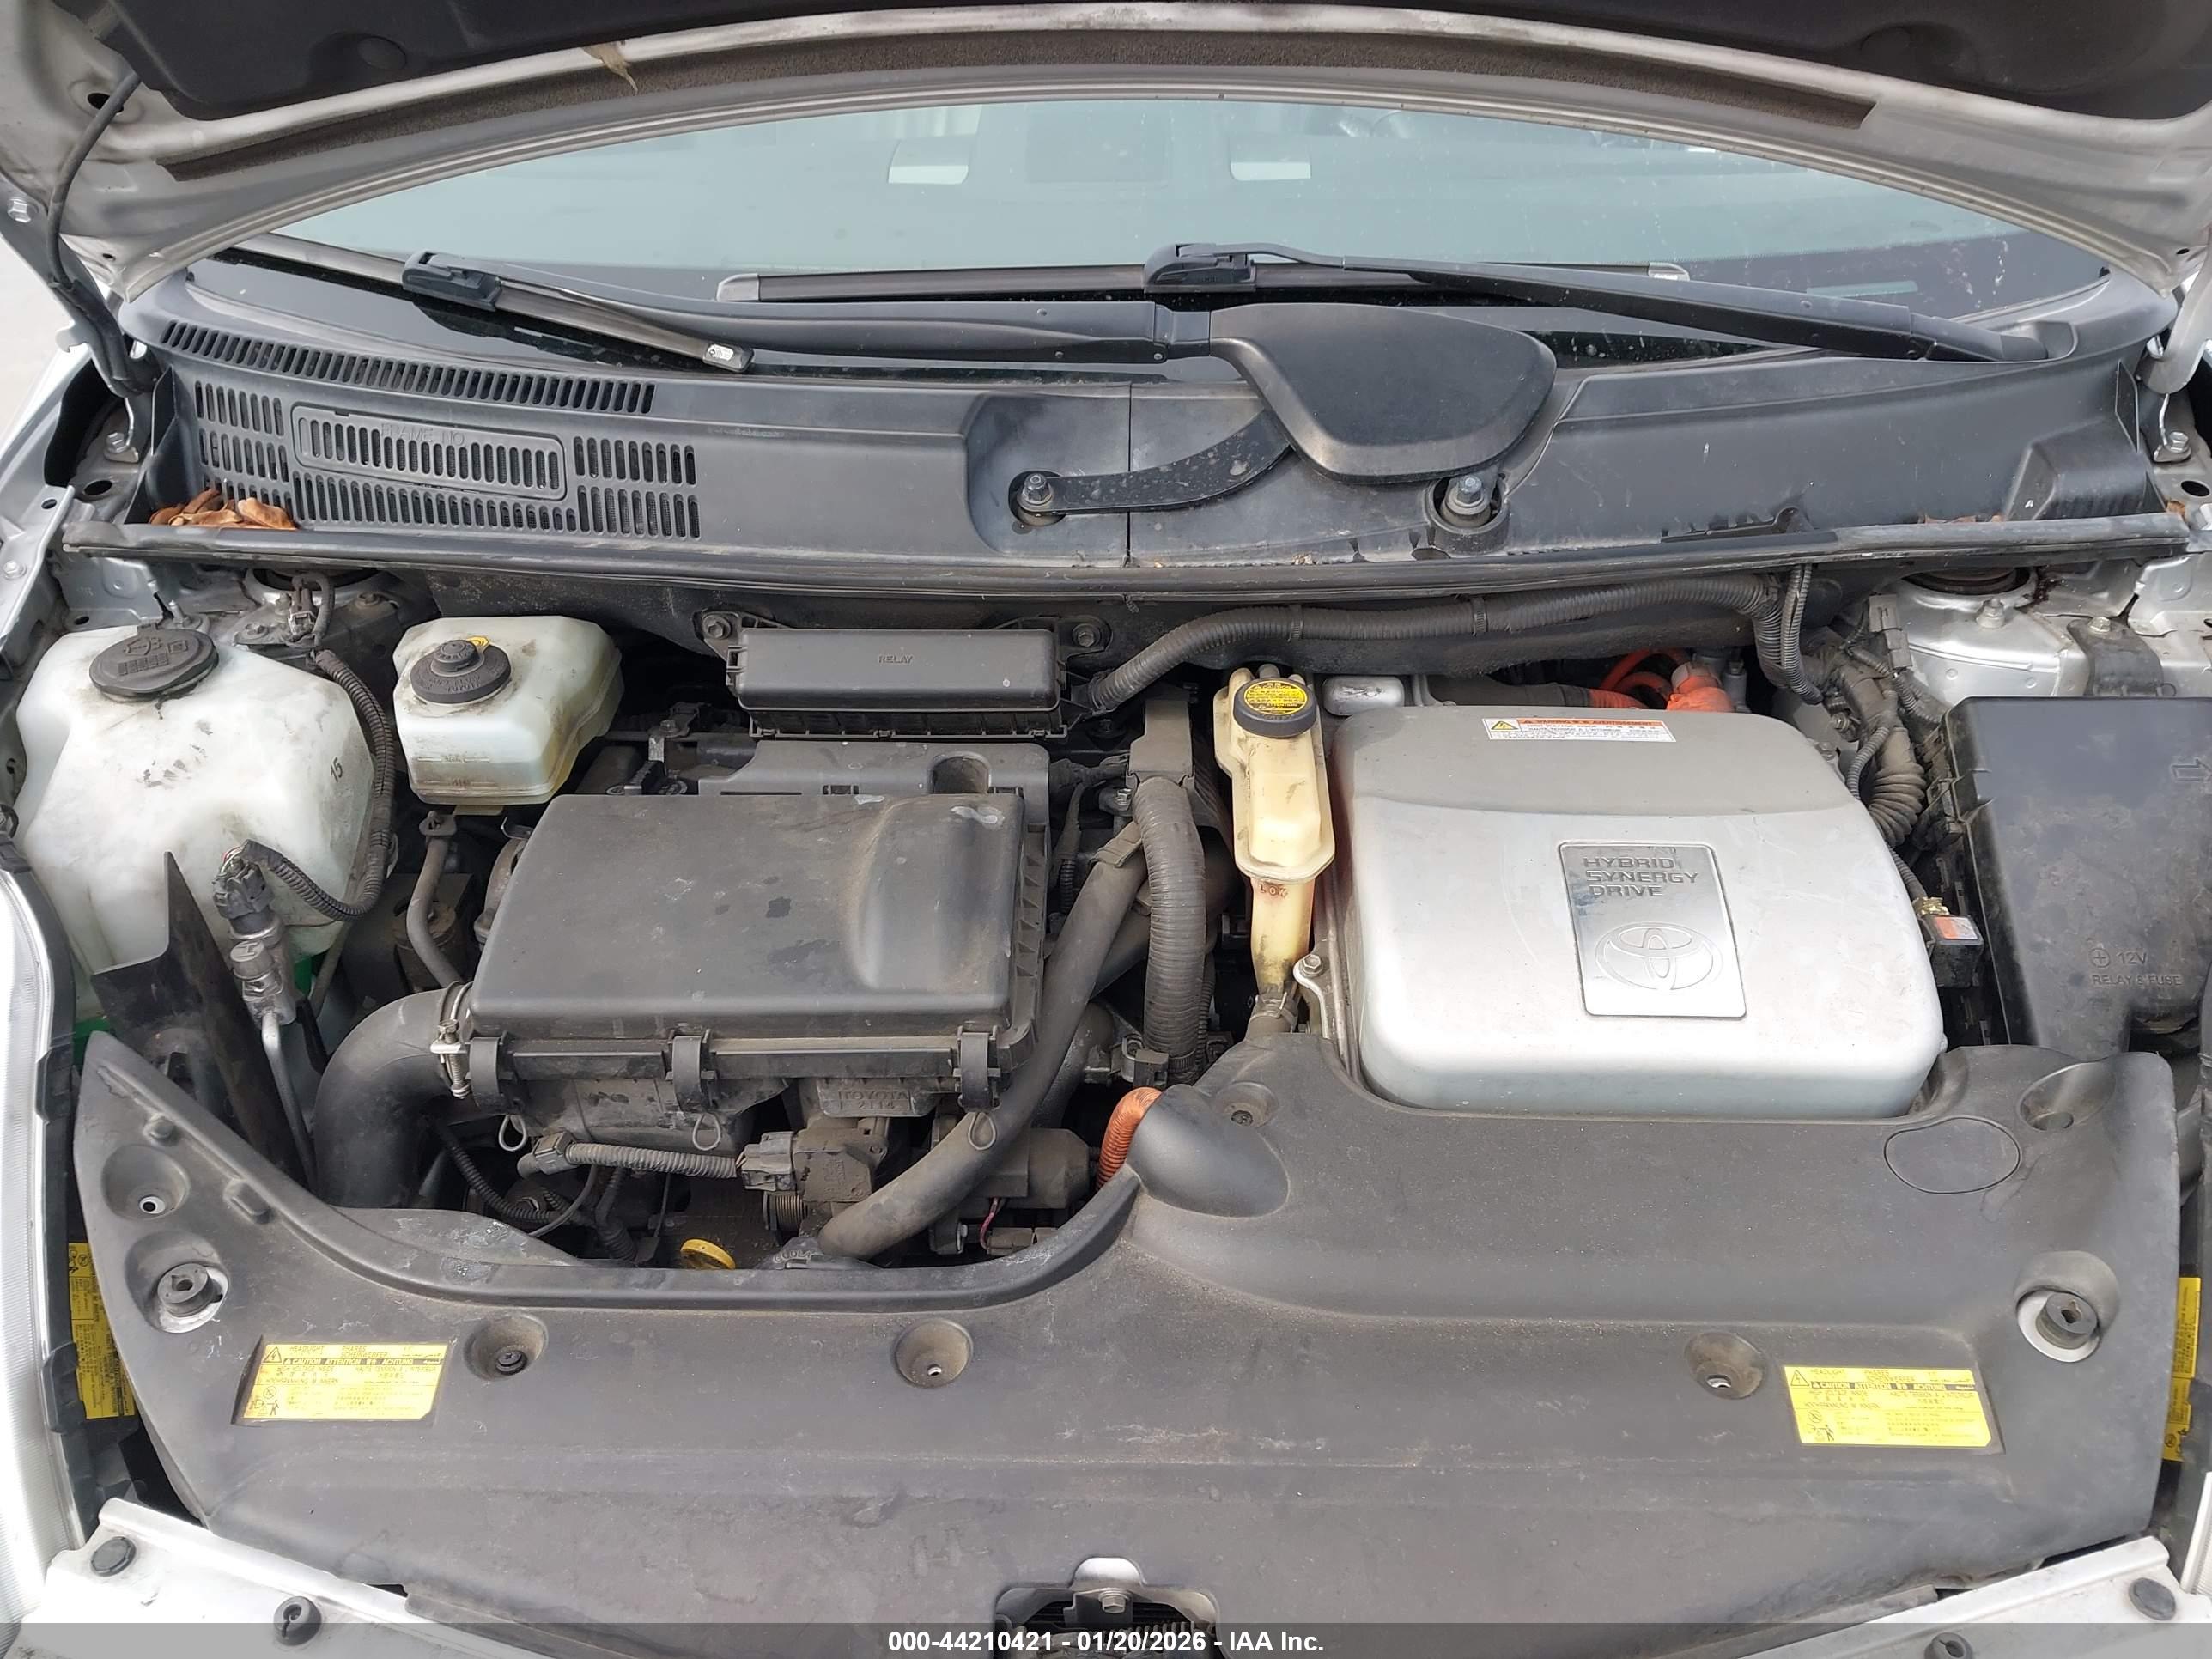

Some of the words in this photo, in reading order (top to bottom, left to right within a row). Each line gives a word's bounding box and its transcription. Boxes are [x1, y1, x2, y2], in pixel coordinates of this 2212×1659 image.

[878, 654, 913, 664] RELAY
[1583, 857, 1675, 869] HYBRID
[1585, 870, 1699, 884] SYNERGY
[1259, 882, 1289, 899] LOW
[1589, 884, 1663, 897] DRIVE
[2117, 951, 2147, 964] 12V
[2091, 974, 2132, 986] RELAY
[2148, 974, 2183, 986] FUSE
[1854, 1382, 1891, 1390] ATTENTION
